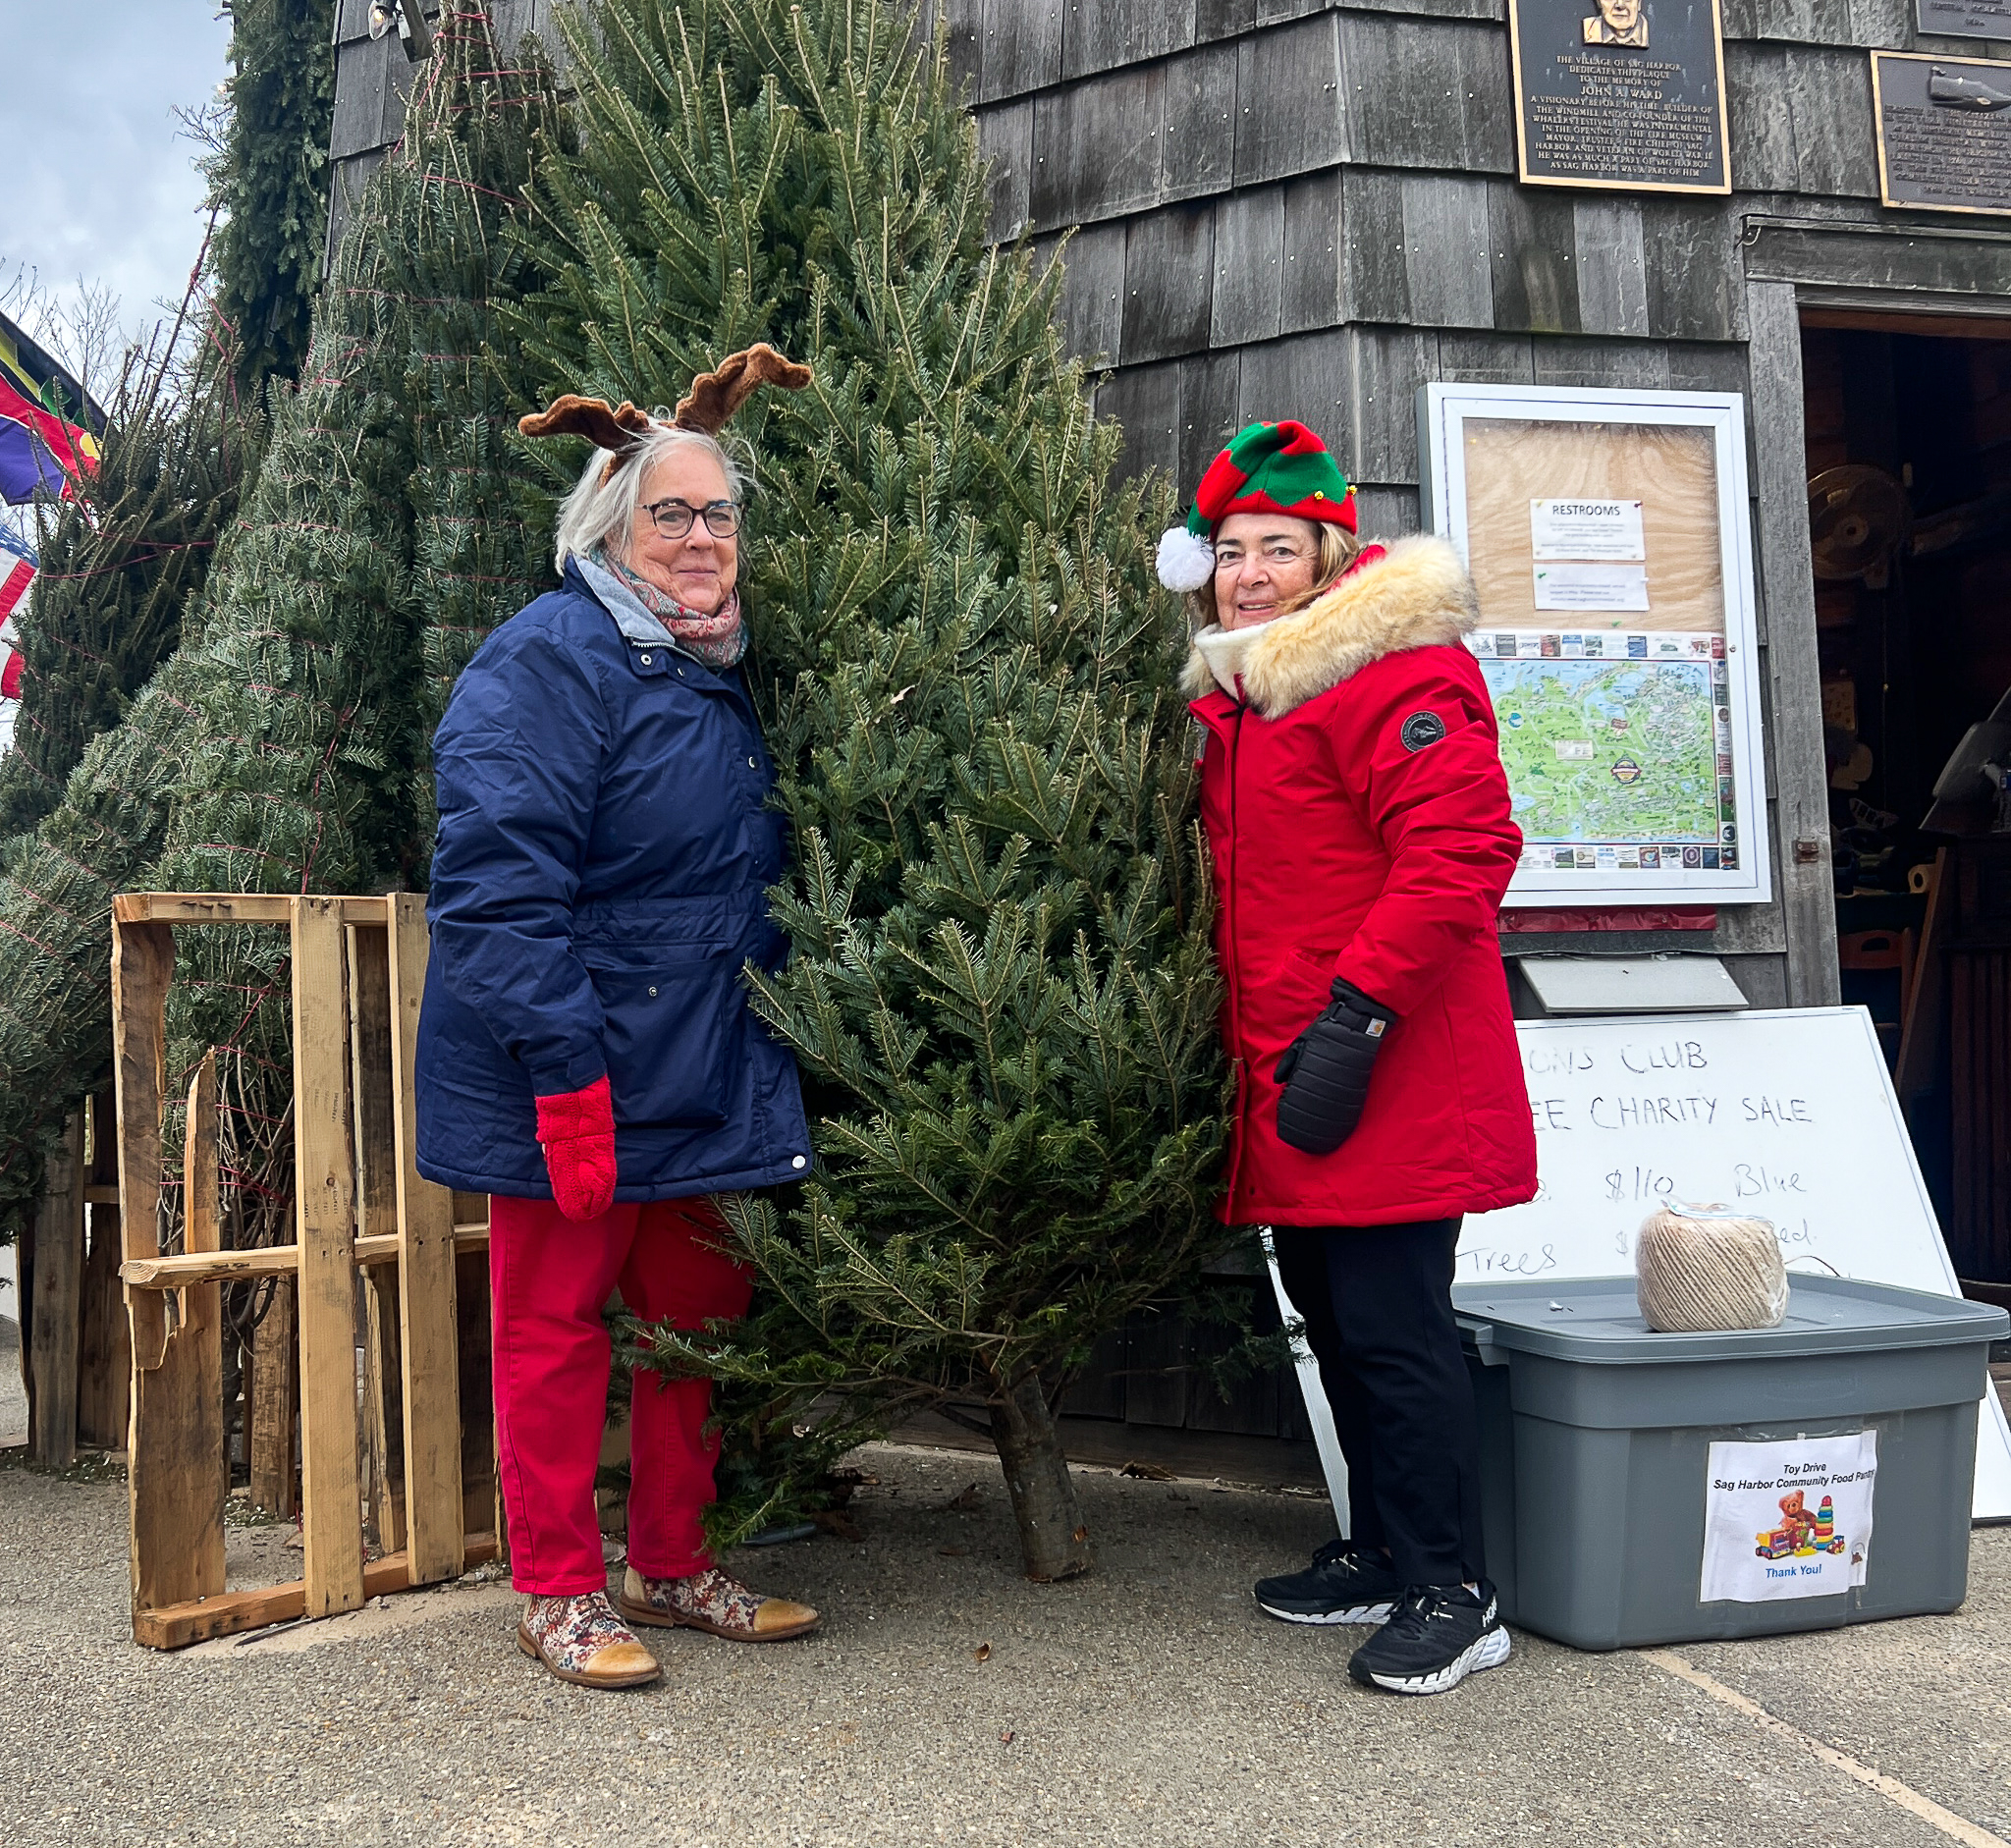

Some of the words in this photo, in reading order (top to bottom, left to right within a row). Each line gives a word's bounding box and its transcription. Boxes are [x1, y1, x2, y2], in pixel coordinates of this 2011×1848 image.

[1552, 505, 1621, 516] RESTROOMS
[1529, 1045, 1596, 1075] ONS
[1620, 1041, 1709, 1074] CLUB
[1530, 1099, 1573, 1131] EE
[1590, 1096, 1717, 1130] CHARITY
[1741, 1095, 1816, 1127] SALE
[1605, 1166, 1673, 1203] $110
[1733, 1163, 1808, 1198] Blue
[1454, 1243, 1557, 1276] Trees
[1713, 1479, 1735, 1491] Sag
[1738, 1479, 1774, 1490] Harbor
[1776, 1475, 1829, 1488] Community
[1831, 1472, 1854, 1484] Food
[1784, 1464, 1801, 1476] Toy
[1802, 1462, 1826, 1473] Drive
[1765, 1566, 1797, 1578] Thank
[1800, 1563, 1822, 1575] You!
